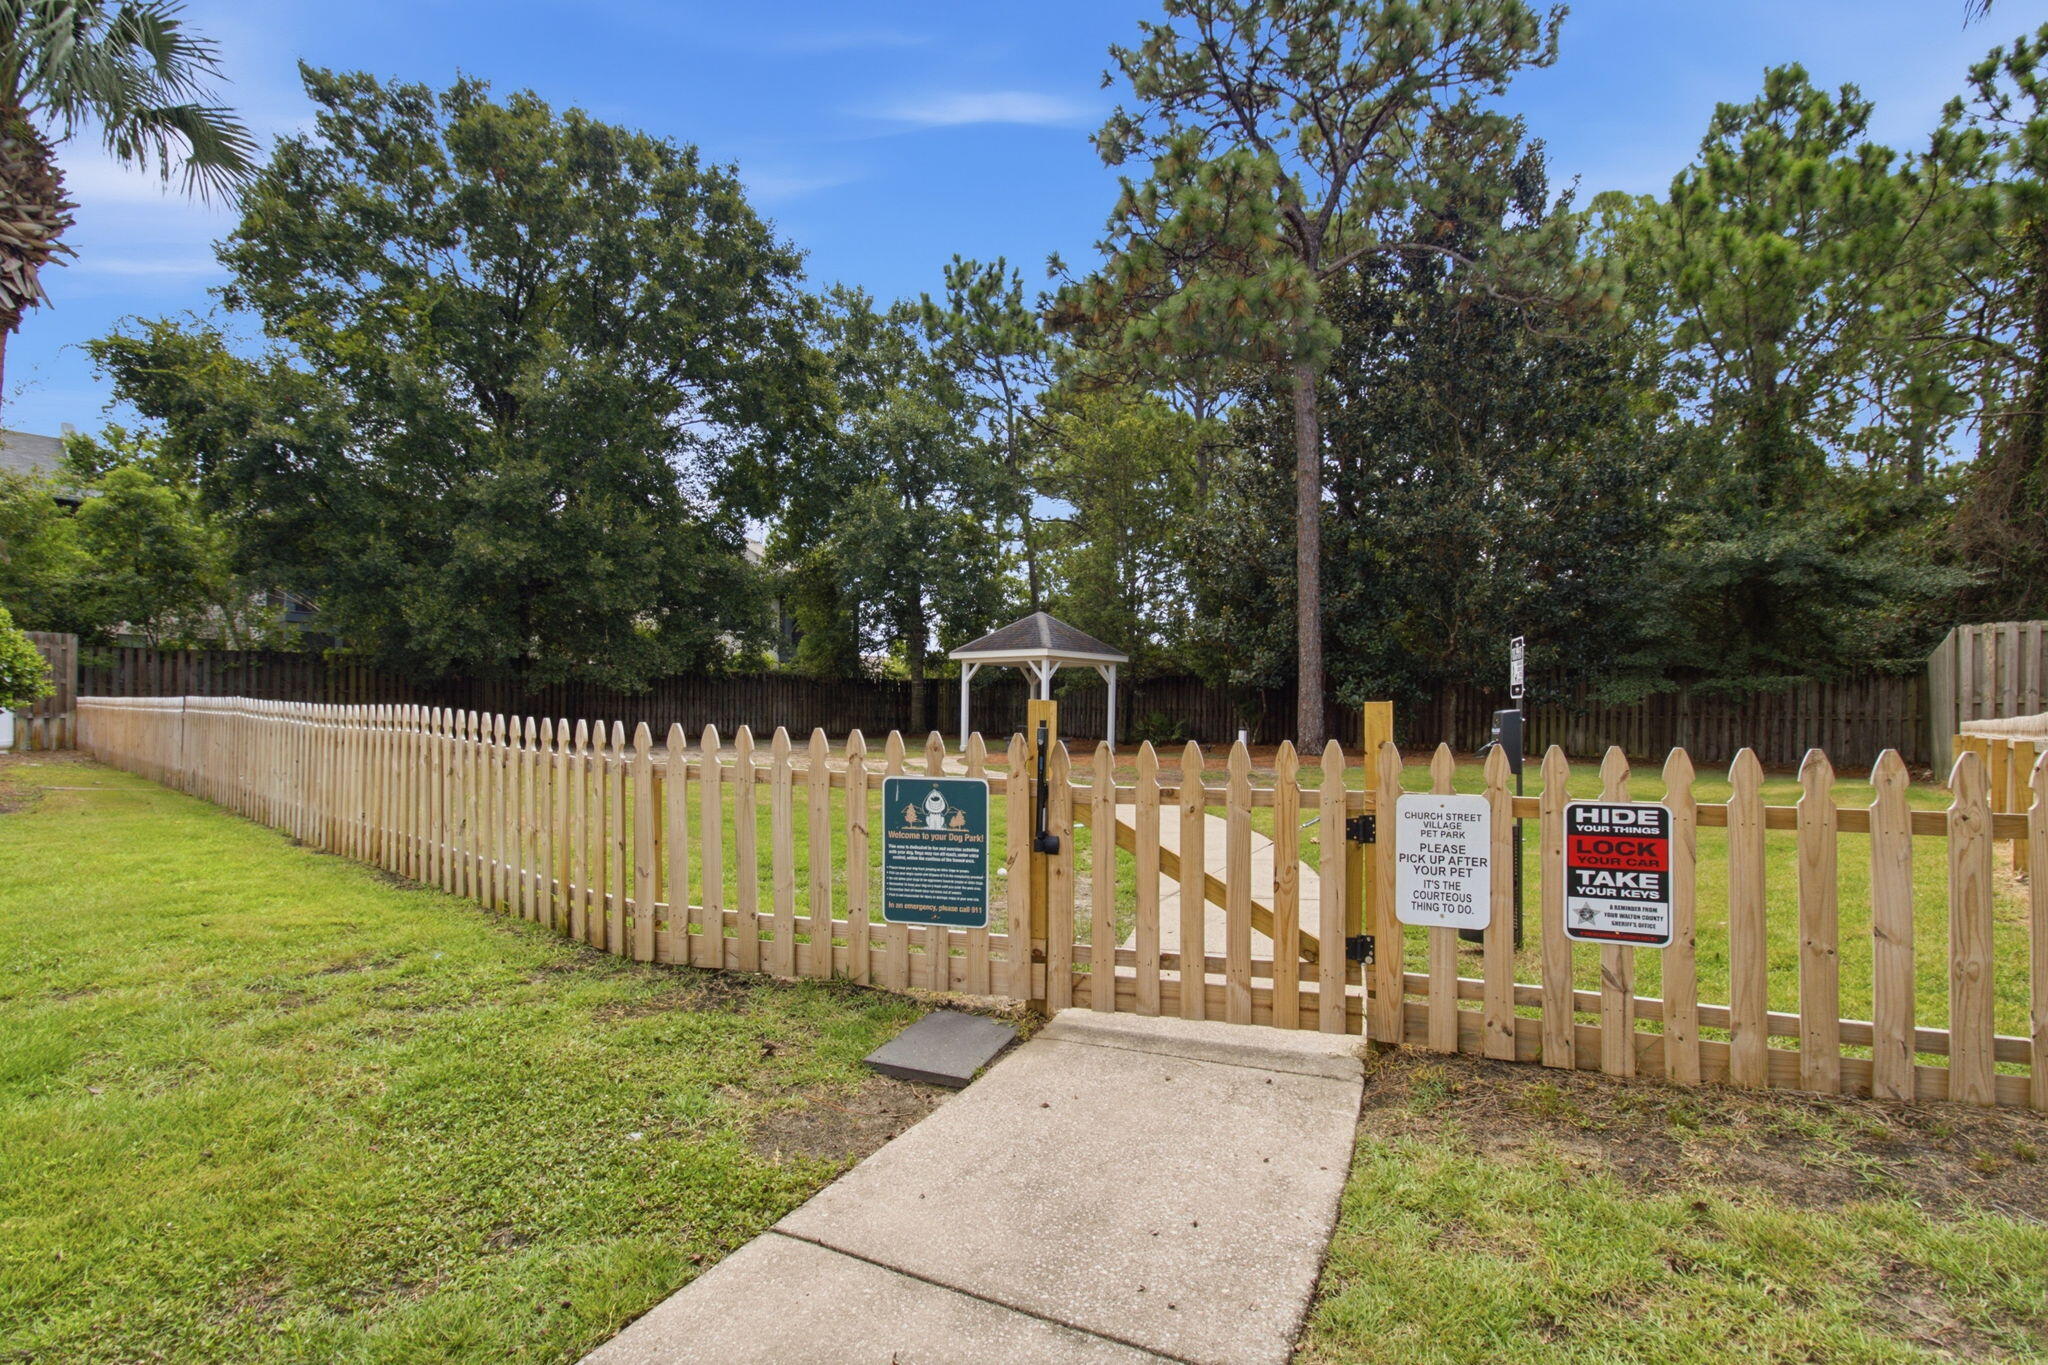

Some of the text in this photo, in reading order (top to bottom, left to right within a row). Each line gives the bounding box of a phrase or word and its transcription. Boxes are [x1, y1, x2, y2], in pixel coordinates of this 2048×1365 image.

[1404, 811, 1482, 822] CHURCH STREET
[1575, 808, 1659, 825] HIDE
[1423, 821, 1462, 830] VILLAGE
[1612, 826, 1660, 835] THINGS
[888, 831, 920, 839] Welcome
[931, 833, 947, 842] your
[948, 833, 963, 843] Dog
[964, 834, 984, 843] Park!
[1420, 829, 1465, 839] PET PARK
[1420, 843, 1466, 855] PLEASE
[1576, 839, 1657, 857] LOCK
[1399, 853, 1488, 867] PICK UP AFTER
[1578, 856, 1659, 868] YOUR CAR
[1413, 865, 1473, 878] YOUR PET
[1424, 880, 1461, 891] IT'S THE
[1575, 870, 1659, 889] TAKE
[1413, 890, 1472, 903] COURTEOUS
[1576, 886, 1660, 900] YOUR KEYS
[888, 900, 894, 908] In
[904, 903, 937, 912] emergency,
[1411, 901, 1475, 915] THING TO DO.
